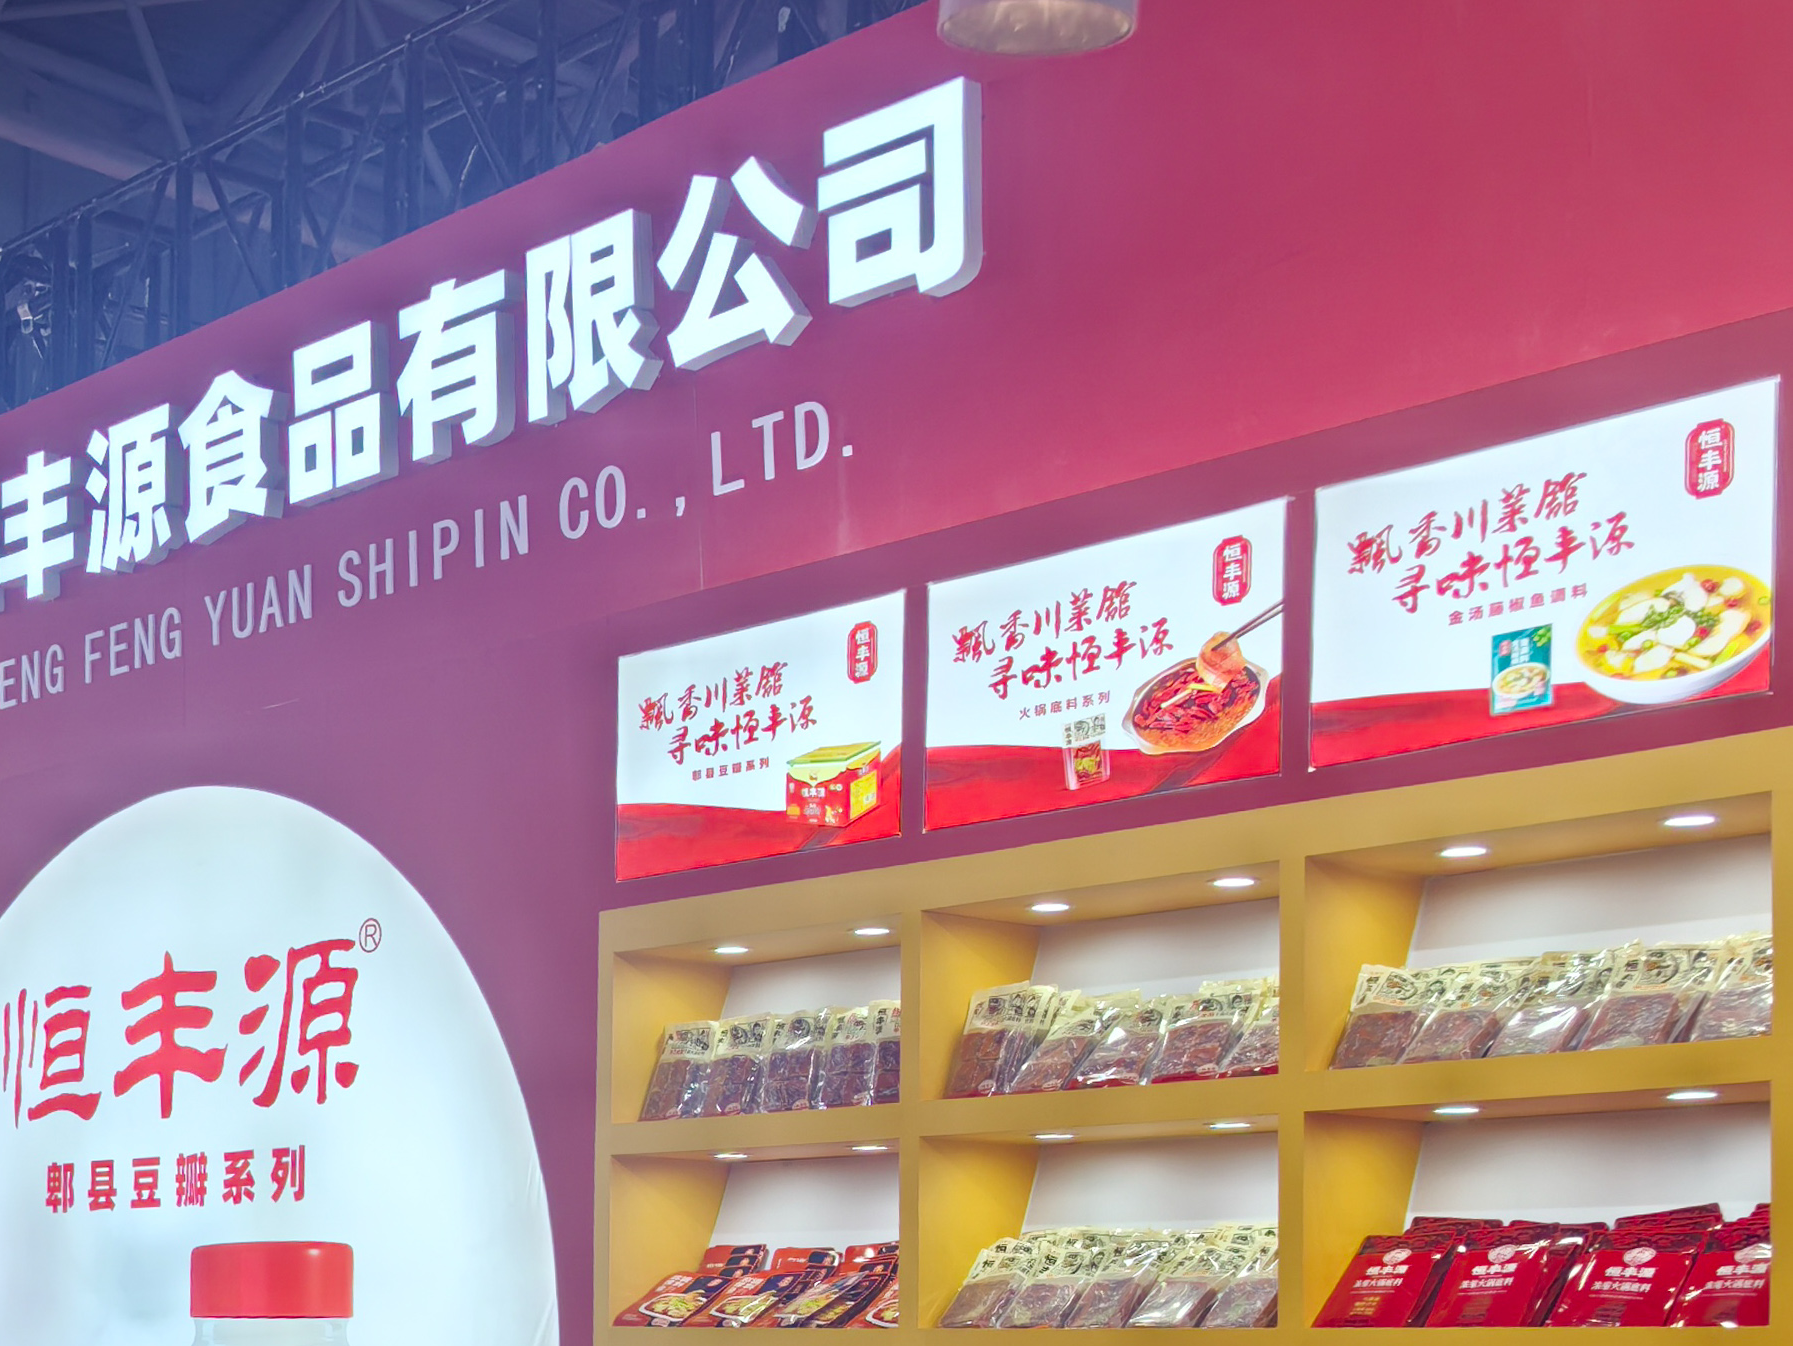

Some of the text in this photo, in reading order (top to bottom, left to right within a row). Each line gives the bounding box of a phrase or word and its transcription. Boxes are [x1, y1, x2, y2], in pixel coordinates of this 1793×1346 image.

[1696, 428, 1723, 493] 恒丰源
[83, 607, 183, 684] FENG
[204, 565, 313, 646] YUAN
[337, 494, 530, 607] SHIPIN
[1221, 543, 1242, 601] 恒丰源
[1447, 582, 1589, 626] 金汤藤椒鱼调料
[854, 627, 872, 679] 恒丰源
[1018, 690, 1111, 721] 火锅底料系列
[3, 938, 360, 1129] 恒丰源
[44, 1144, 307, 1214] 郫县豆瓣系列
